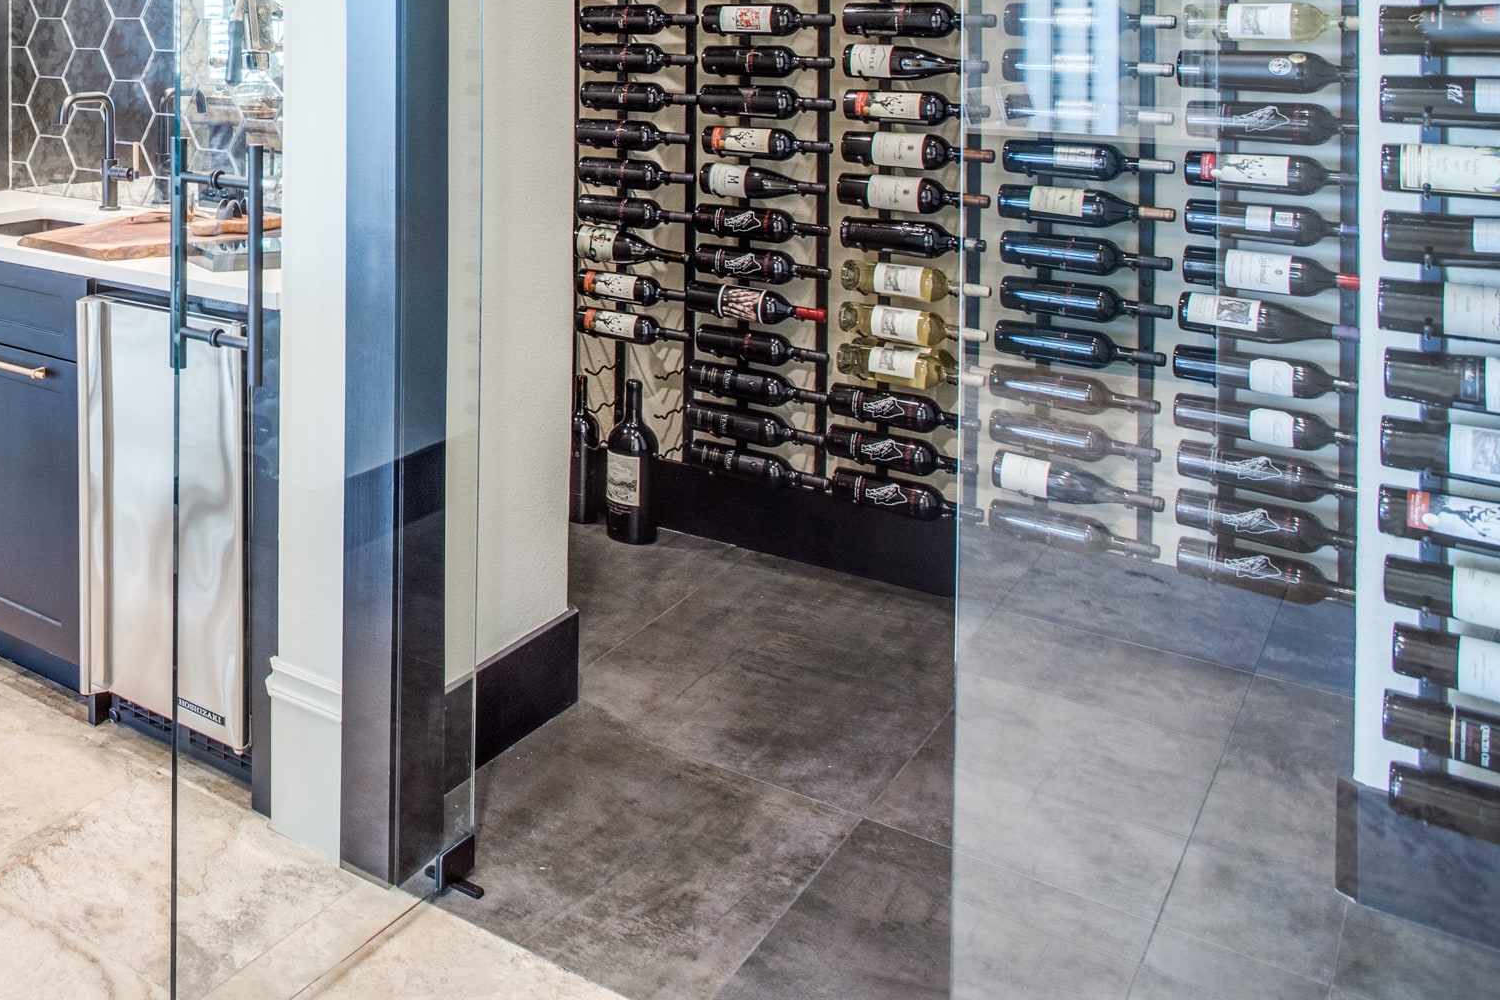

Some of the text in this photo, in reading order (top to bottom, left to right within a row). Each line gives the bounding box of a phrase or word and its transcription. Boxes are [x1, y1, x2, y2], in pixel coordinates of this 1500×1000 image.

[727, 174, 740, 185] M
[726, 449, 735, 470] VENGE
[178, 698, 222, 724] HOSHIZAKI
